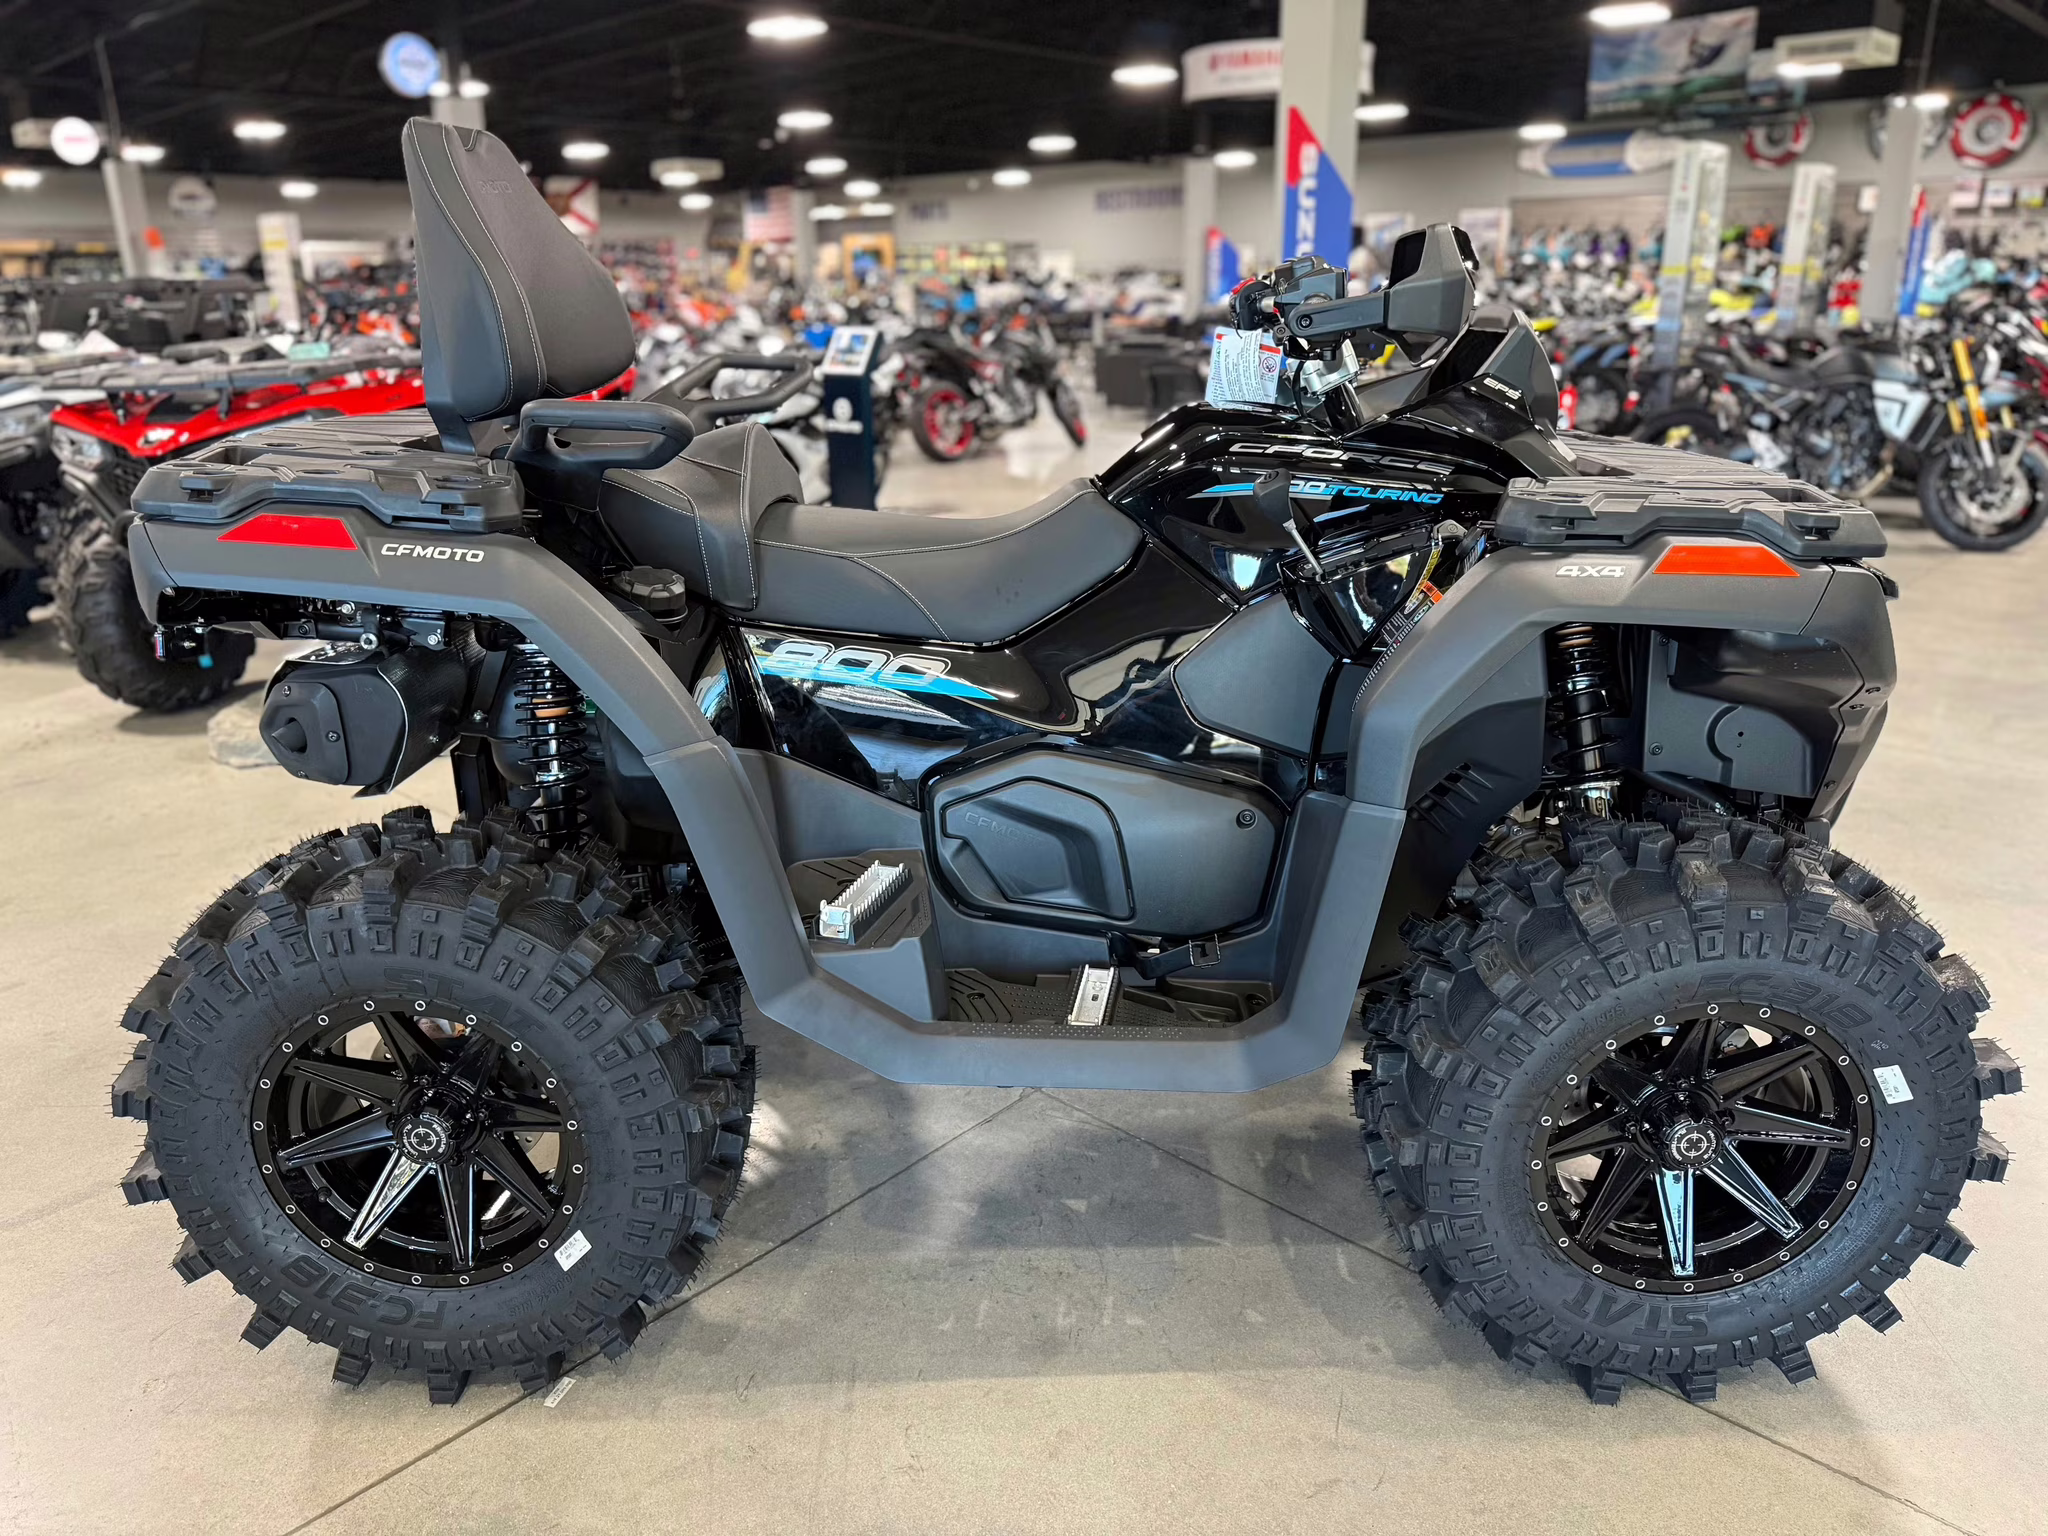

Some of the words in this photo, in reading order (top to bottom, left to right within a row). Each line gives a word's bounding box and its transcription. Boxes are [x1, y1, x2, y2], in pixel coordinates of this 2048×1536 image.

[1483, 377, 1521, 400] EPS
[1228, 442, 1455, 475] CFORCE
[1325, 484, 1445, 505] TOURING
[381, 543, 485, 563] CFMOTO
[768, 638, 952, 684] 800
[1559, 1282, 1710, 1338] STAT
